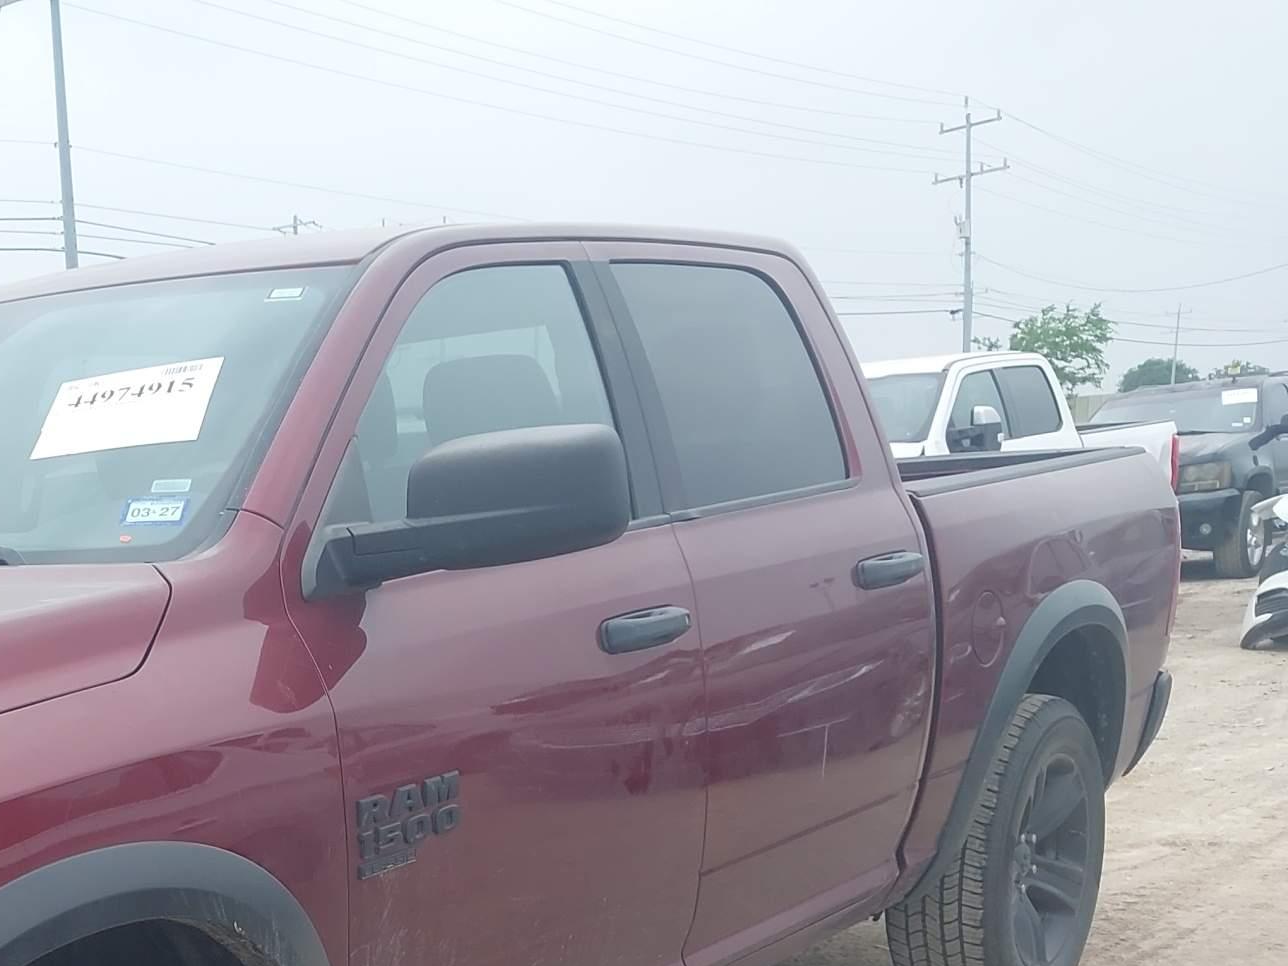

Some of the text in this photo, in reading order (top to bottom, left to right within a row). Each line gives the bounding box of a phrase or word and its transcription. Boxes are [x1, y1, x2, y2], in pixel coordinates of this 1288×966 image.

[67, 377, 196, 408] 44974915
[357, 769, 460, 828] RAM
[360, 803, 461, 860] 1500
